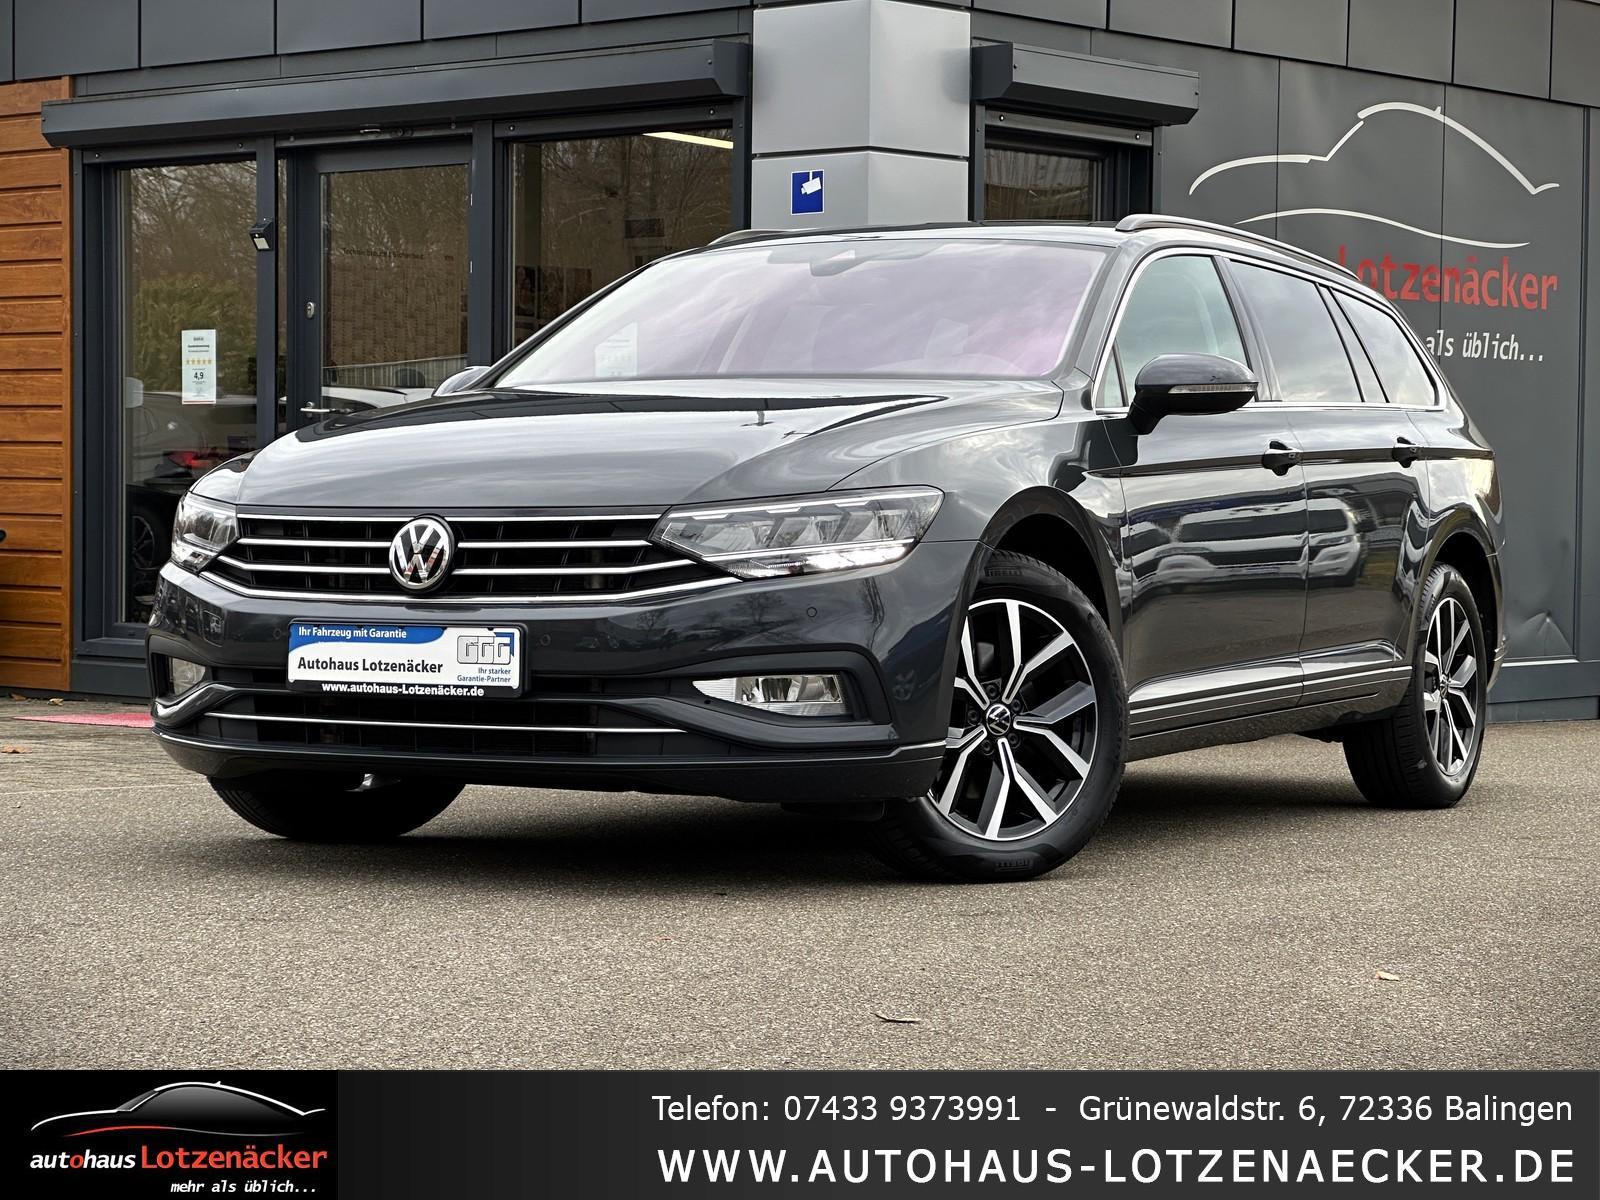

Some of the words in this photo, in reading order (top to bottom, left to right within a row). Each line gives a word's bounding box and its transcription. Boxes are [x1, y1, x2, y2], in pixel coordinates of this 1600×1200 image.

[1425, 329, 1454, 357] als
[1462, 331, 1544, 362] üblich...
[193, 371, 204, 380] 4,9
[299, 627, 311, 637] Ihr
[312, 627, 352, 639] Fahrzeug
[353, 628, 368, 638] mit
[369, 628, 407, 639] Garantie
[298, 656, 359, 671] Autohaus
[362, 658, 443, 674] Lotzenäcker
[478, 667, 488, 675] Ihr
[488, 667, 512, 675] starker
[457, 674, 512, 683] Garantie-Partner
[321, 682, 485, 697] www.autohaus-Lotzenäcker.de
